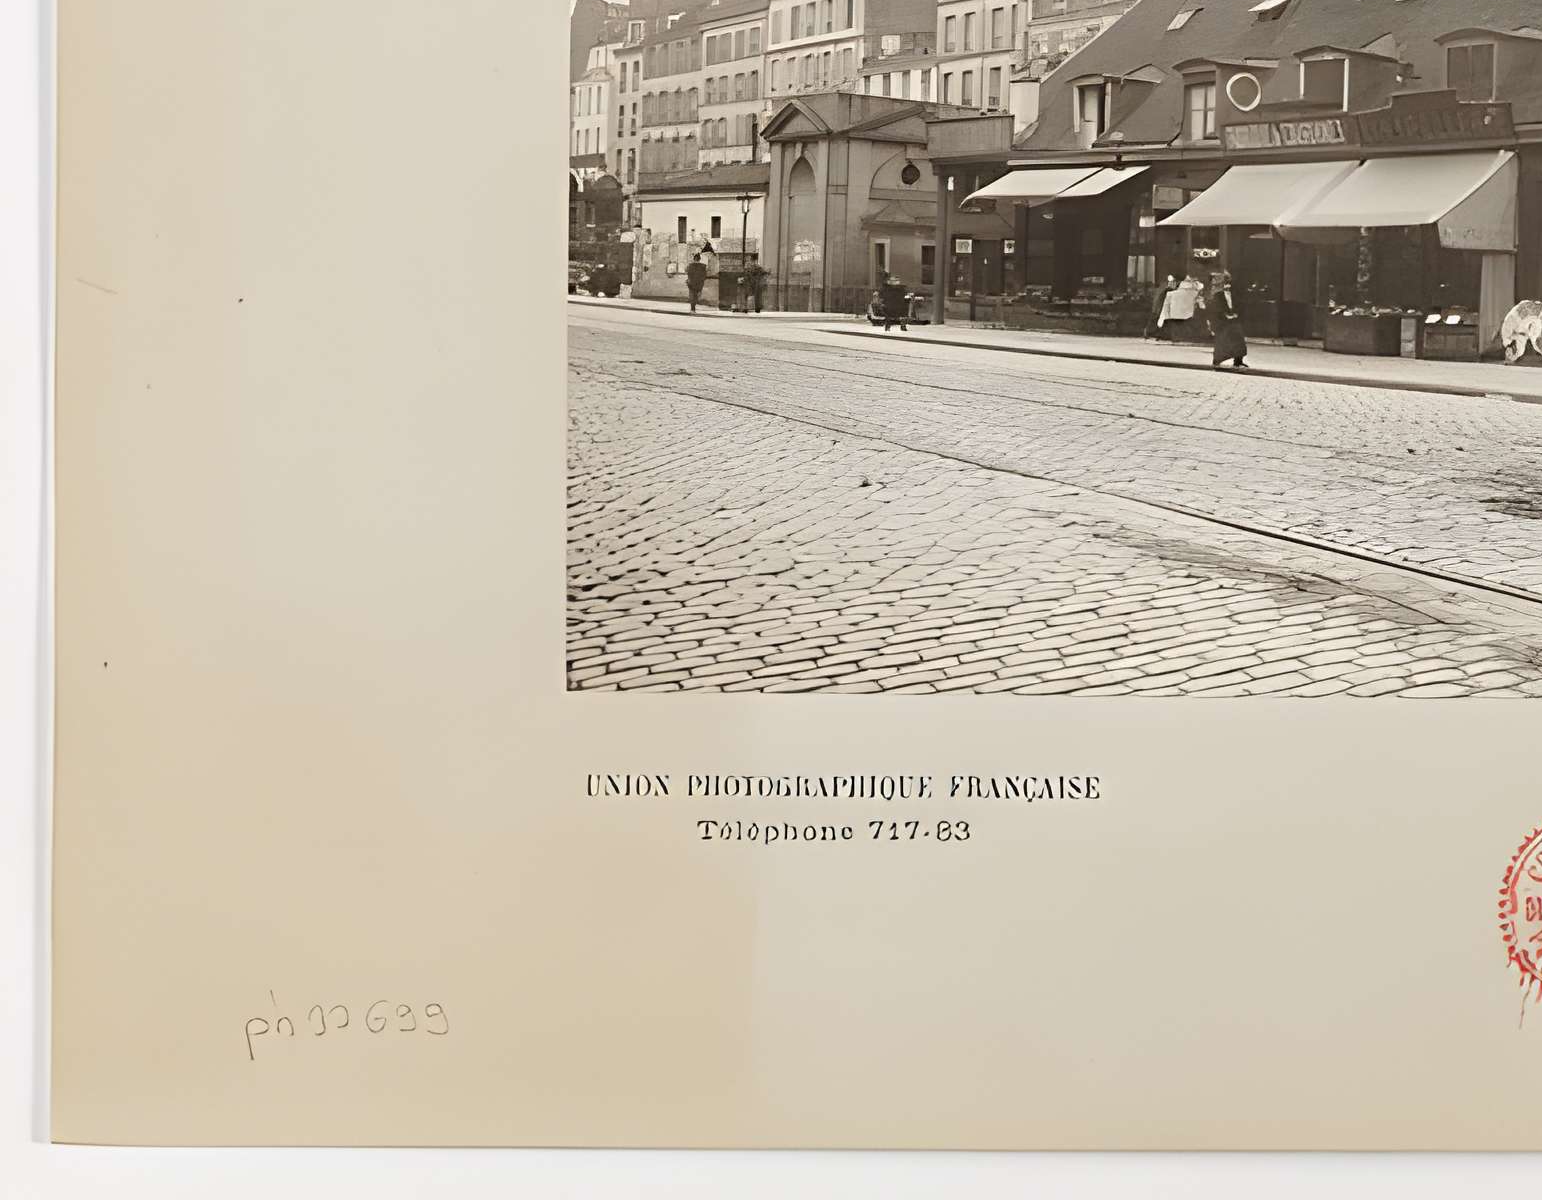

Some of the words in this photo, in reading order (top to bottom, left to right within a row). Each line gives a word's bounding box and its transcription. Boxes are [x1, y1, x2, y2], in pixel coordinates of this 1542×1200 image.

[587, 774, 670, 798] UNION
[688, 774, 933, 801] PHOTOGRAPHIQUE
[950, 775, 1101, 802] FRANÇAISE
